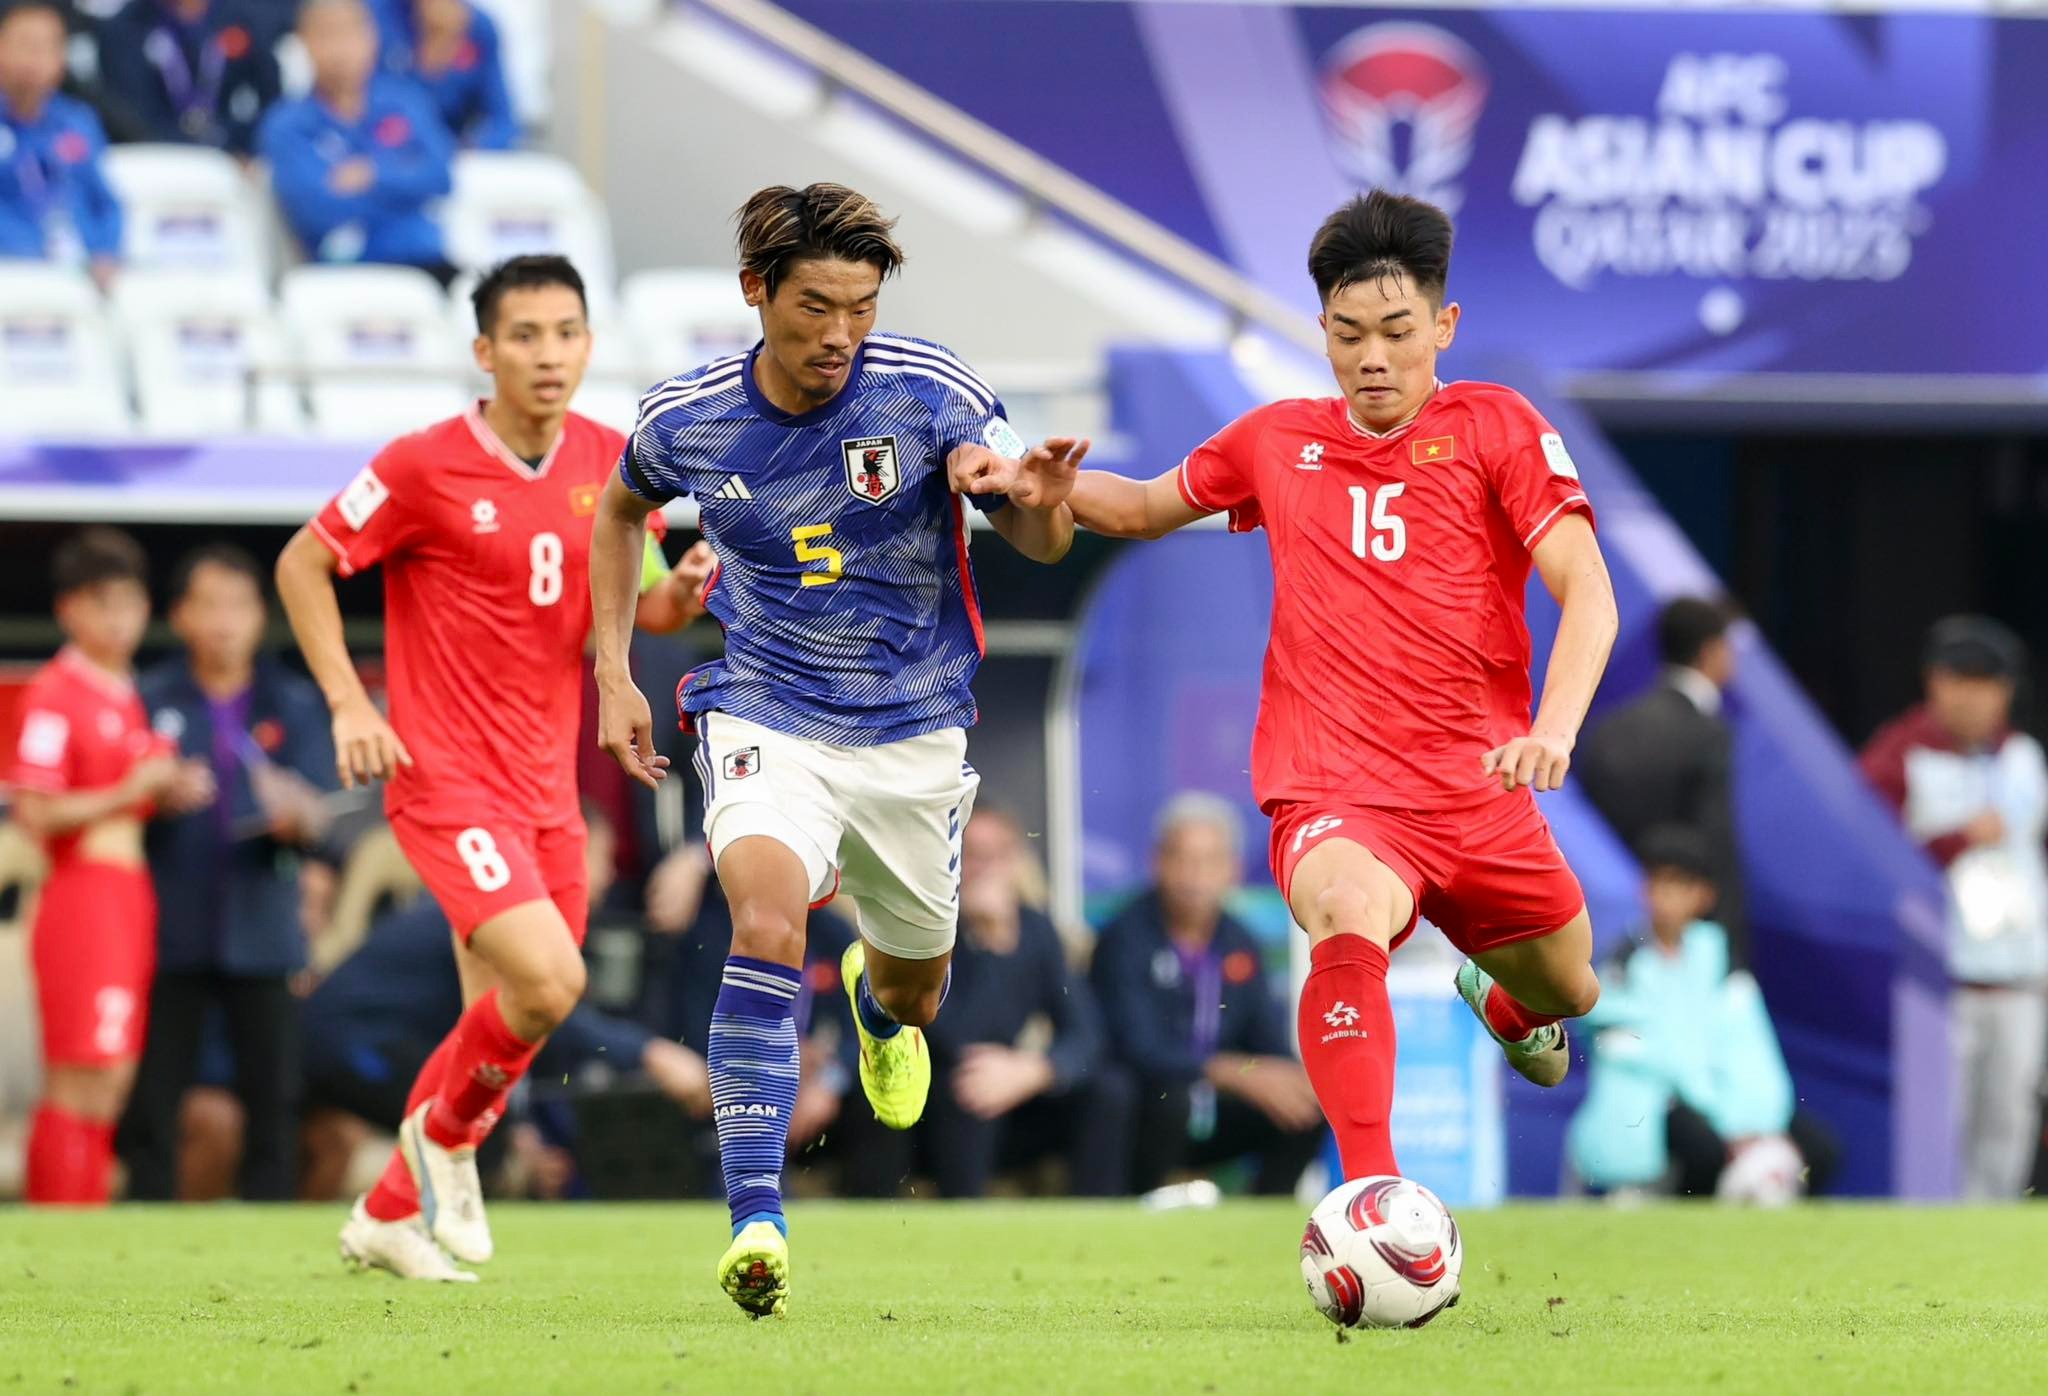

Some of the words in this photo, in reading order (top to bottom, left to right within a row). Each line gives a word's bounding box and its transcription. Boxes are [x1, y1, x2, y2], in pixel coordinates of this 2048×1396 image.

[1658, 53, 1789, 125] AFC
[1513, 115, 1768, 206] ASIAN
[1772, 117, 1946, 208] CUP
[1534, 204, 1749, 288] QATAR
[856, 438, 883, 448] JAPAN
[863, 481, 887, 494] JFA
[790, 522, 842, 587] 5
[1347, 481, 1407, 562] 15
[528, 532, 564, 608] 8
[455, 826, 512, 893] 8
[1292, 814, 1344, 854] 15
[713, 1103, 778, 1122] JAPAN
